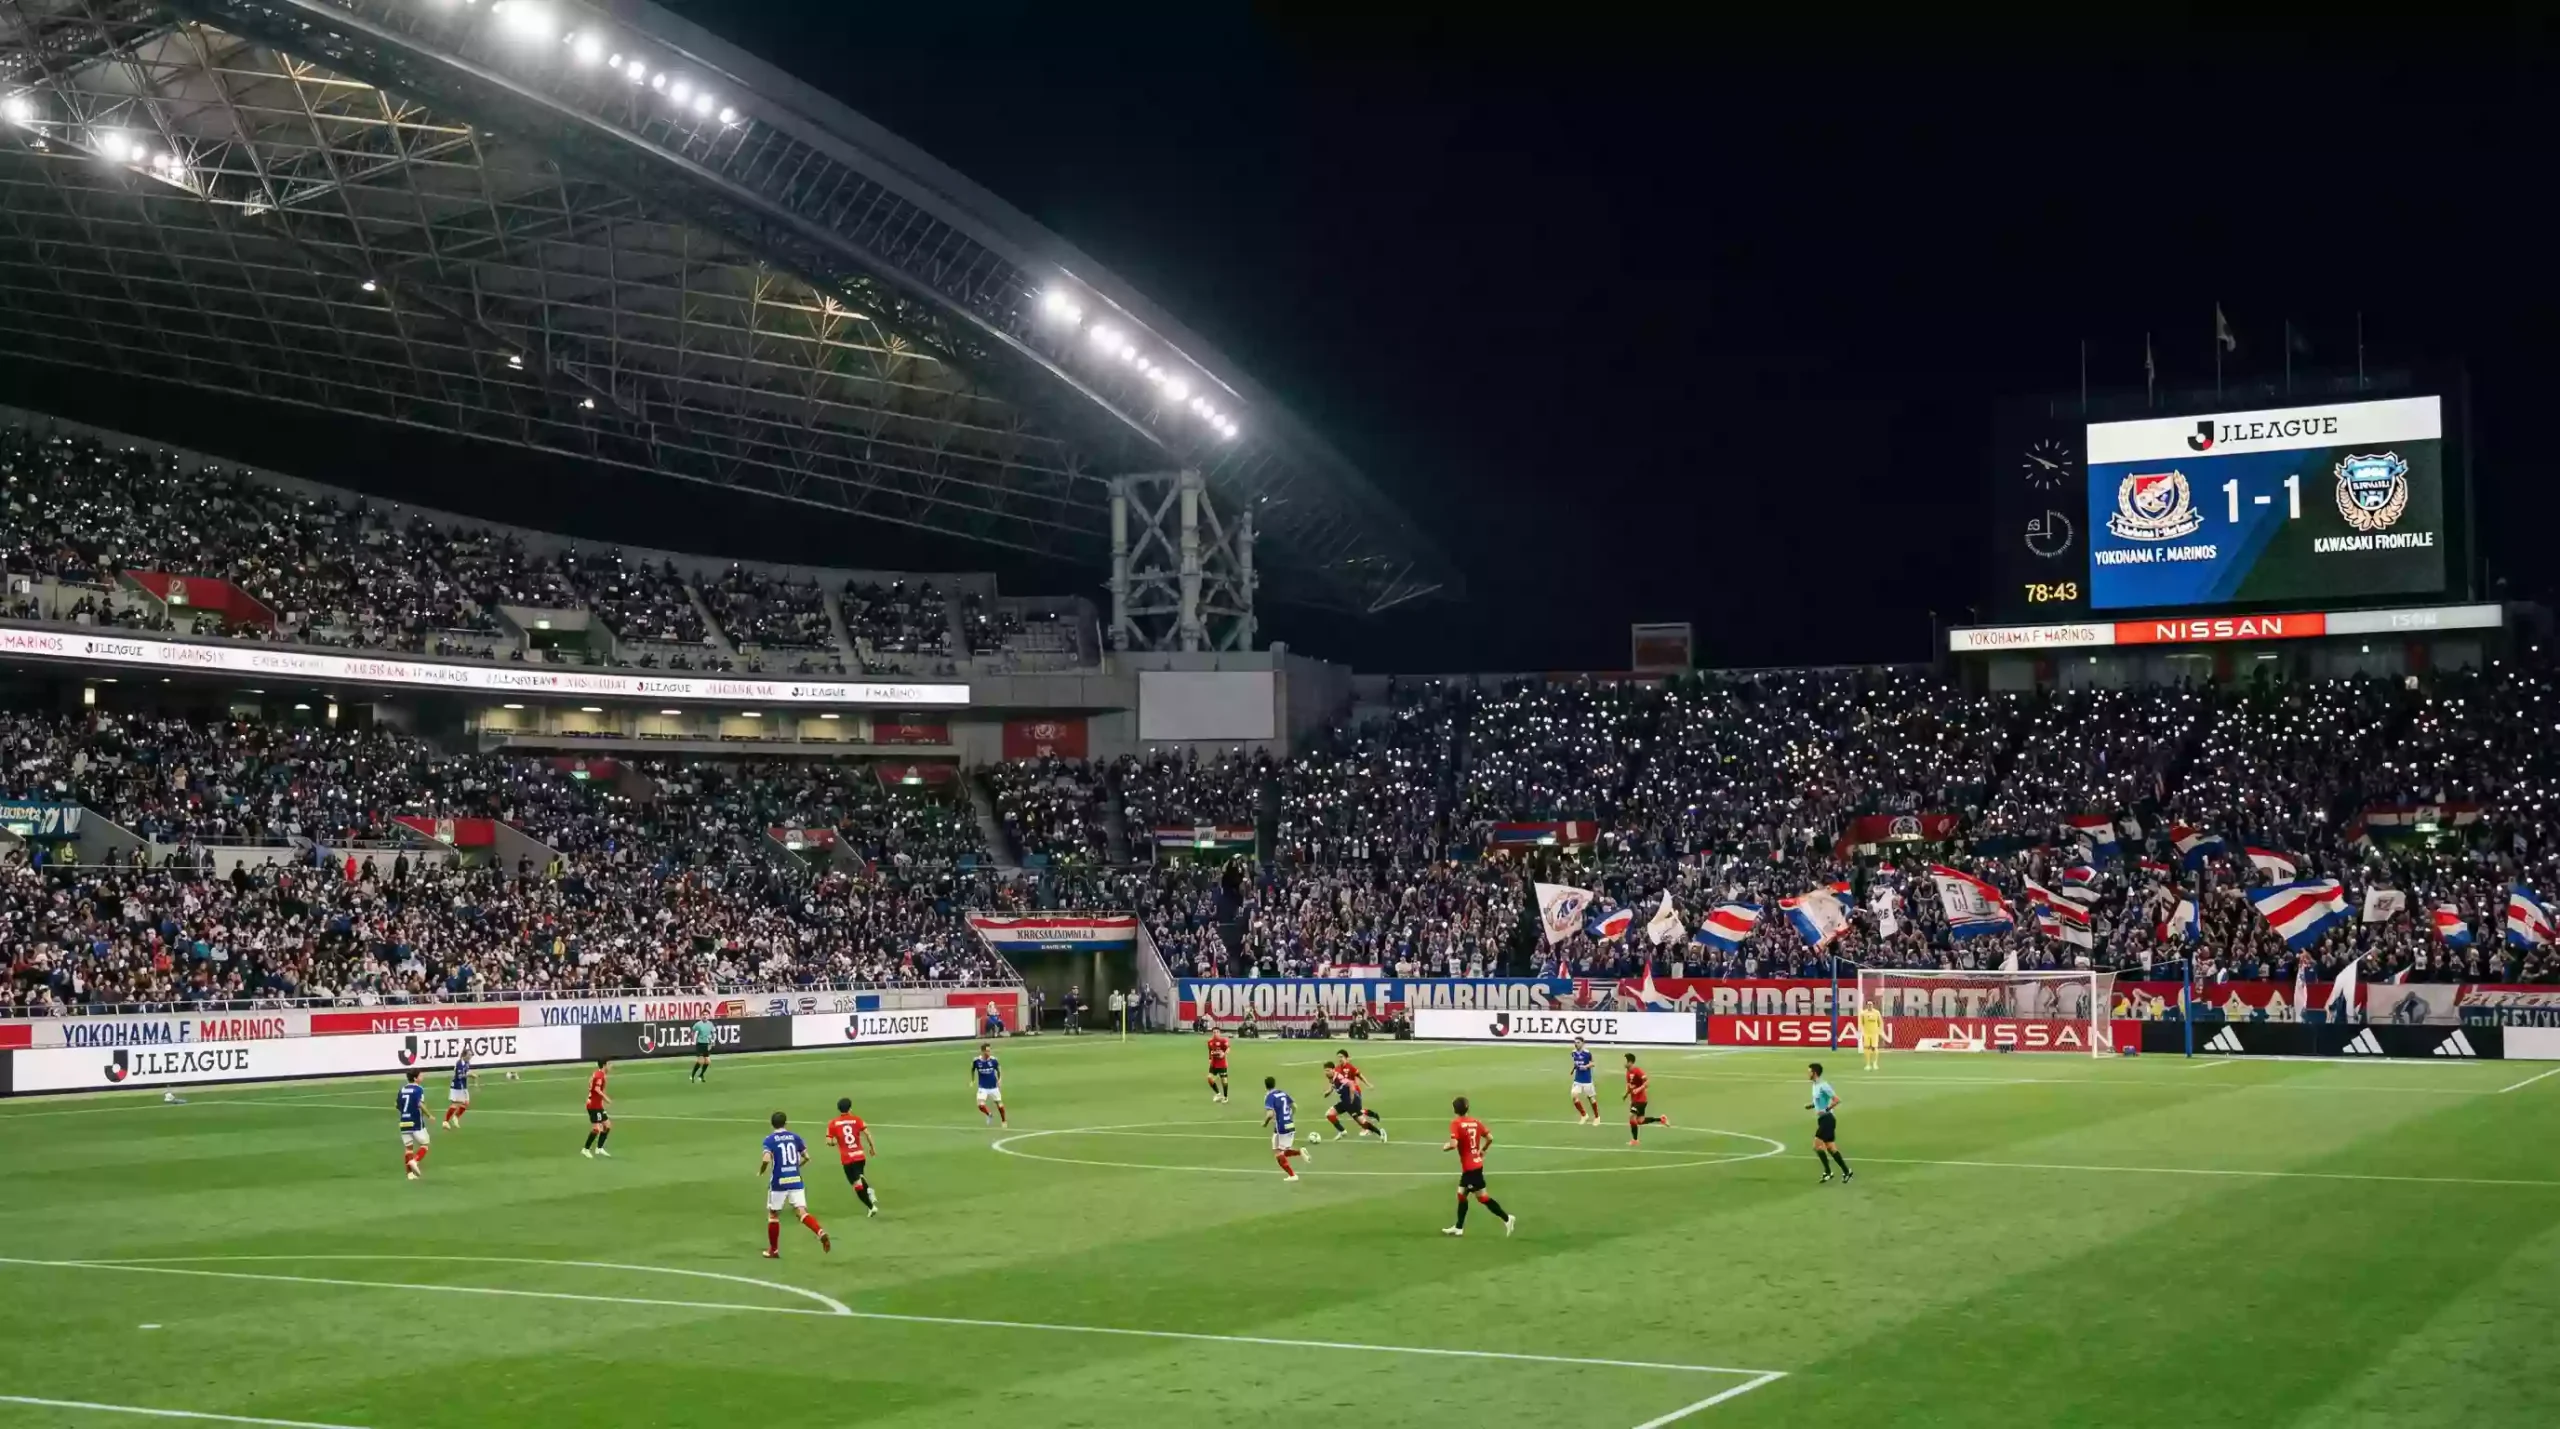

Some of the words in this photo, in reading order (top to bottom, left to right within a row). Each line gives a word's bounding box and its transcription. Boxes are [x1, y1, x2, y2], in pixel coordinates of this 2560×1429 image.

[2220, 417, 2338, 443] J.LEAGUE
[2223, 479, 2239, 523] 1
[2284, 474, 2300, 519] 1
[2167, 544, 2218, 561] MARINOS
[2314, 535, 2373, 553] KAWASAKI
[2375, 532, 2434, 549] FRONTALE
[2025, 582, 2077, 602] 78:43
[2156, 618, 2282, 640] NISSAN
[1190, 983, 1366, 1018] YOKOHAMA
[1404, 983, 1551, 1011] MARINOS
[372, 1015, 459, 1034] NISSAN
[541, 1003, 622, 1025] YOKOHAMA
[62, 1022, 172, 1047] YOKOHAMA
[200, 1018, 285, 1042] MARINOS
[657, 1025, 741, 1047] J.LEUE
[860, 1016, 929, 1035] J.LEAGUE
[1513, 1017, 1618, 1034] J.LEAGUE
[1949, 1023, 2113, 1047] NISSAN
[421, 1035, 516, 1059] J.LEAGUE
[132, 1049, 249, 1076] J.LEAGUE
[401, 1094, 410, 1112] 7
[842, 1126, 855, 1145] 8
[777, 1142, 797, 1165] 10
